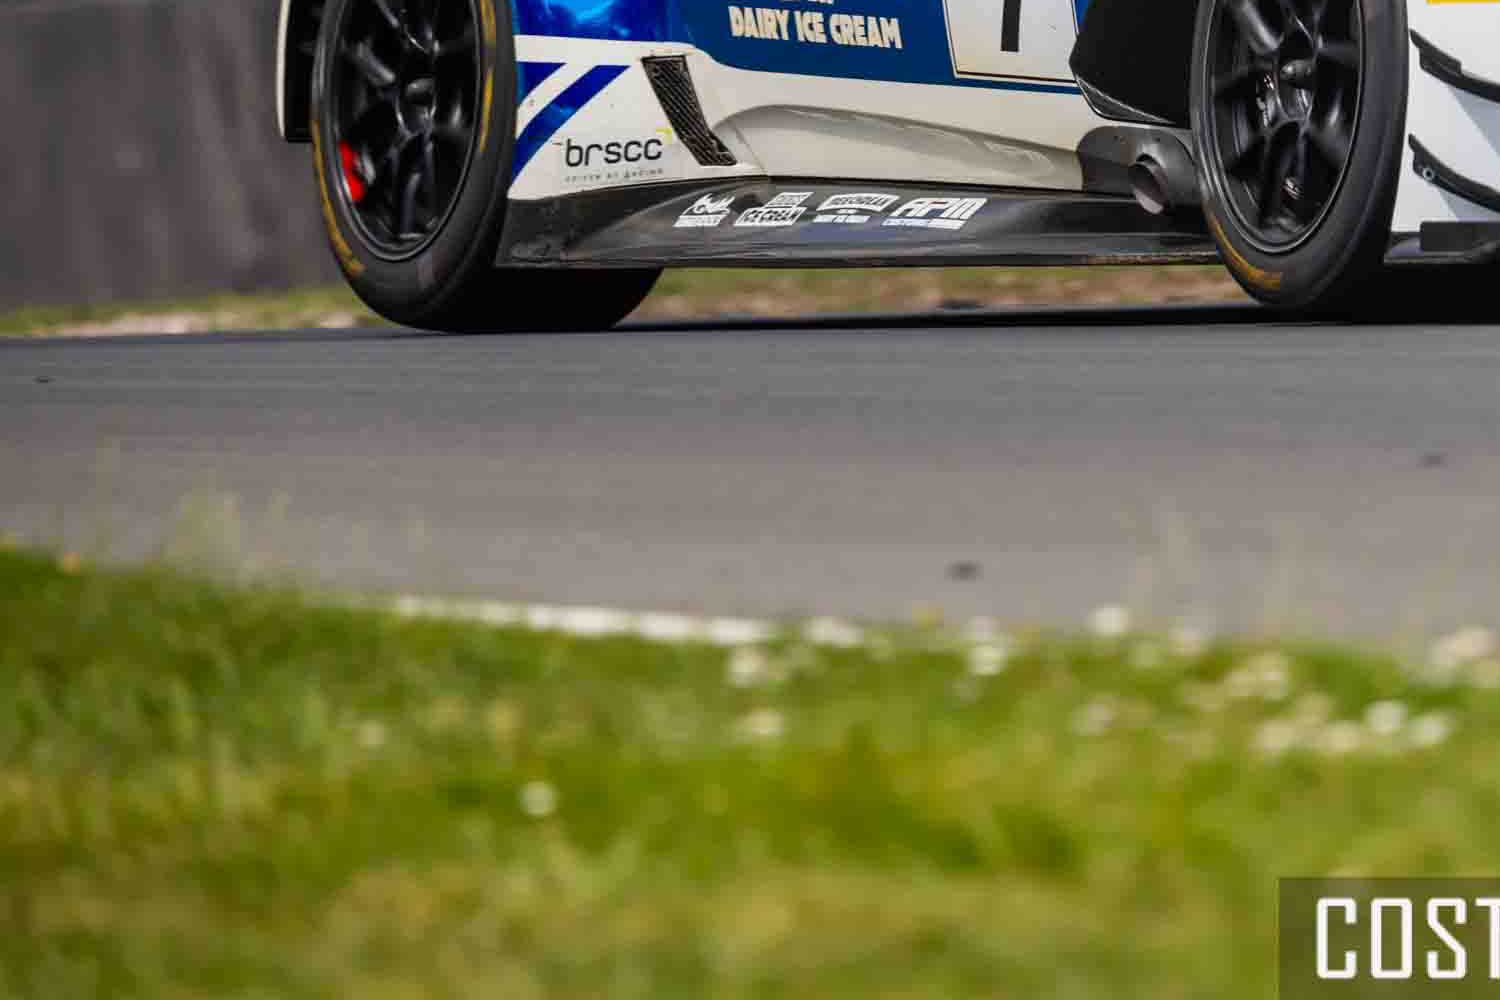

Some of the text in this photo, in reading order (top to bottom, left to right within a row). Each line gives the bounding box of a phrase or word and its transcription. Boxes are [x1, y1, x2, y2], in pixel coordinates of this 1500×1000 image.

[728, 6, 903, 49] DAIRY ICE CREAM
[565, 138, 662, 167] brscc
